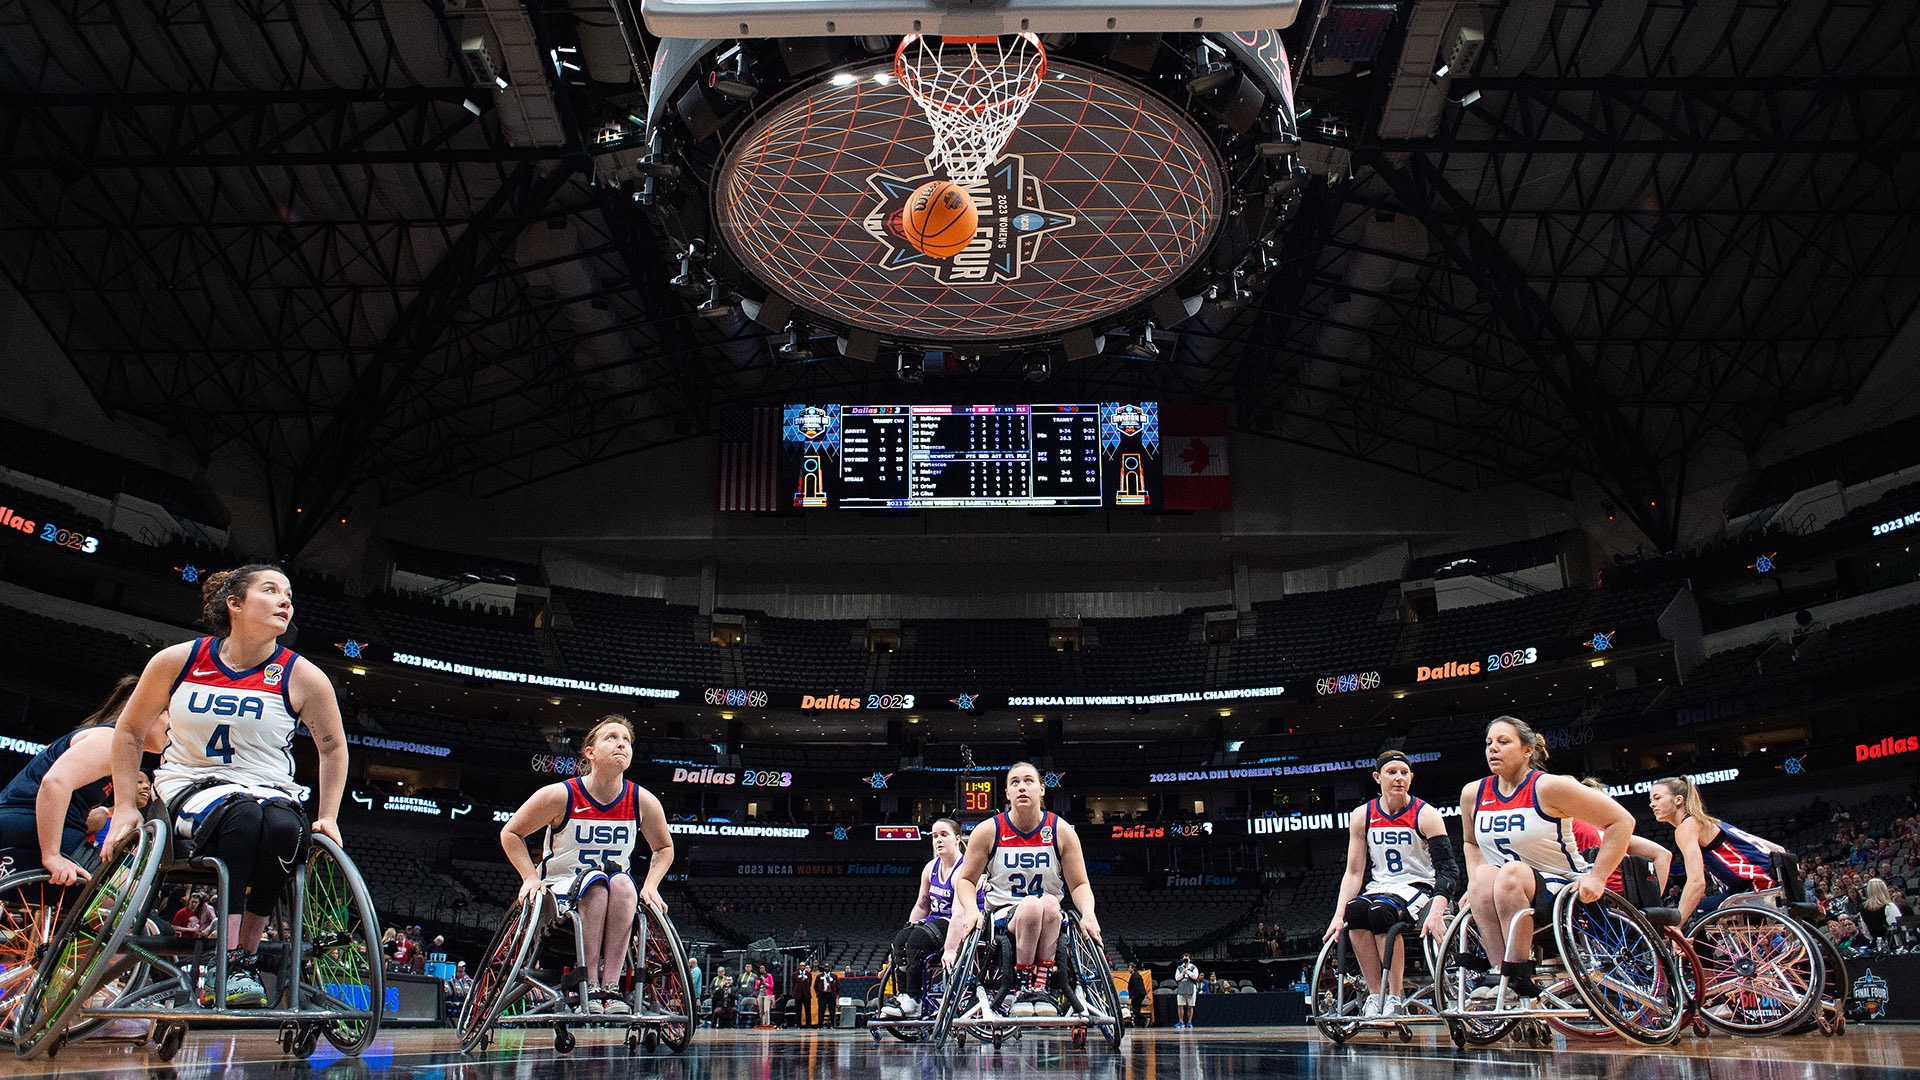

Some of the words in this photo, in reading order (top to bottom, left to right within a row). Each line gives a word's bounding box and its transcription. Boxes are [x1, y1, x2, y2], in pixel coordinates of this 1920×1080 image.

[997, 194, 1008, 215] 2023
[998, 216, 1008, 249] WOMEN'S
[0, 507, 35, 534] llas
[40, 523, 99, 553] 2023
[1872, 517, 1903, 536] 2023
[1417, 661, 1480, 681] Dallas
[1487, 647, 1537, 671] 2023
[393, 652, 421, 667] 2023
[422, 658, 452, 672] NCAA
[453, 664, 473, 675] DIII
[474, 668, 527, 682] WOMEN'S
[528, 674, 597, 691] BASKETBALL
[599, 683, 680, 699] CHAMPIONSHIP
[801, 695, 860, 710] Dallas
[867, 694, 915, 709] 2023
[1008, 697, 1034, 706] 2023
[1035, 697, 1064, 705] NCAA
[1065, 697, 1083, 705] DIII
[1085, 695, 1134, 705] WOMEN'S
[1135, 692, 1202, 704] BASKETBALL
[1203, 686, 1284, 701] CHAMPIONSHIP
[188, 692, 264, 720] USA
[0, 736, 46, 756] PIONS
[206, 725, 235, 763] 4
[362, 737, 451, 757] CHAMPIONSHIP
[1855, 736, 1919, 761] Dallas
[673, 768, 736, 785] Dallas
[742, 770, 792, 787] 2023
[1150, 774, 1177, 783] 2023
[1178, 772, 1208, 781] NCAA
[1230, 767, 1283, 779] WOMEN'S
[1284, 760, 1354, 775] BASKETBALL
[965, 782, 991, 792] 11:49
[383, 802, 441, 815] CHAMPIONSHIP
[388, 795, 438, 808] BASKETBALL
[966, 792, 988, 810] 30
[667, 823, 717, 836] KETBALL
[719, 825, 809, 839] CHAMPIONSHIP
[1480, 814, 1525, 833] USA
[575, 825, 629, 844] USA
[1372, 832, 1412, 845] USA
[1494, 838, 1521, 862] 5
[738, 865, 764, 874] 2023
[767, 865, 793, 874] NCAA
[797, 864, 843, 874] WOMEN'S
[847, 864, 880, 874] Final
[881, 864, 912, 874] Four
[1004, 852, 1050, 868] USA
[1385, 849, 1404, 873] 8
[1008, 873, 1044, 898] 24
[1167, 874, 1202, 886] Final
[1205, 875, 1238, 886] Four
[1855, 988, 1870, 998] FINAL
[1871, 987, 1887, 998] FOUR
